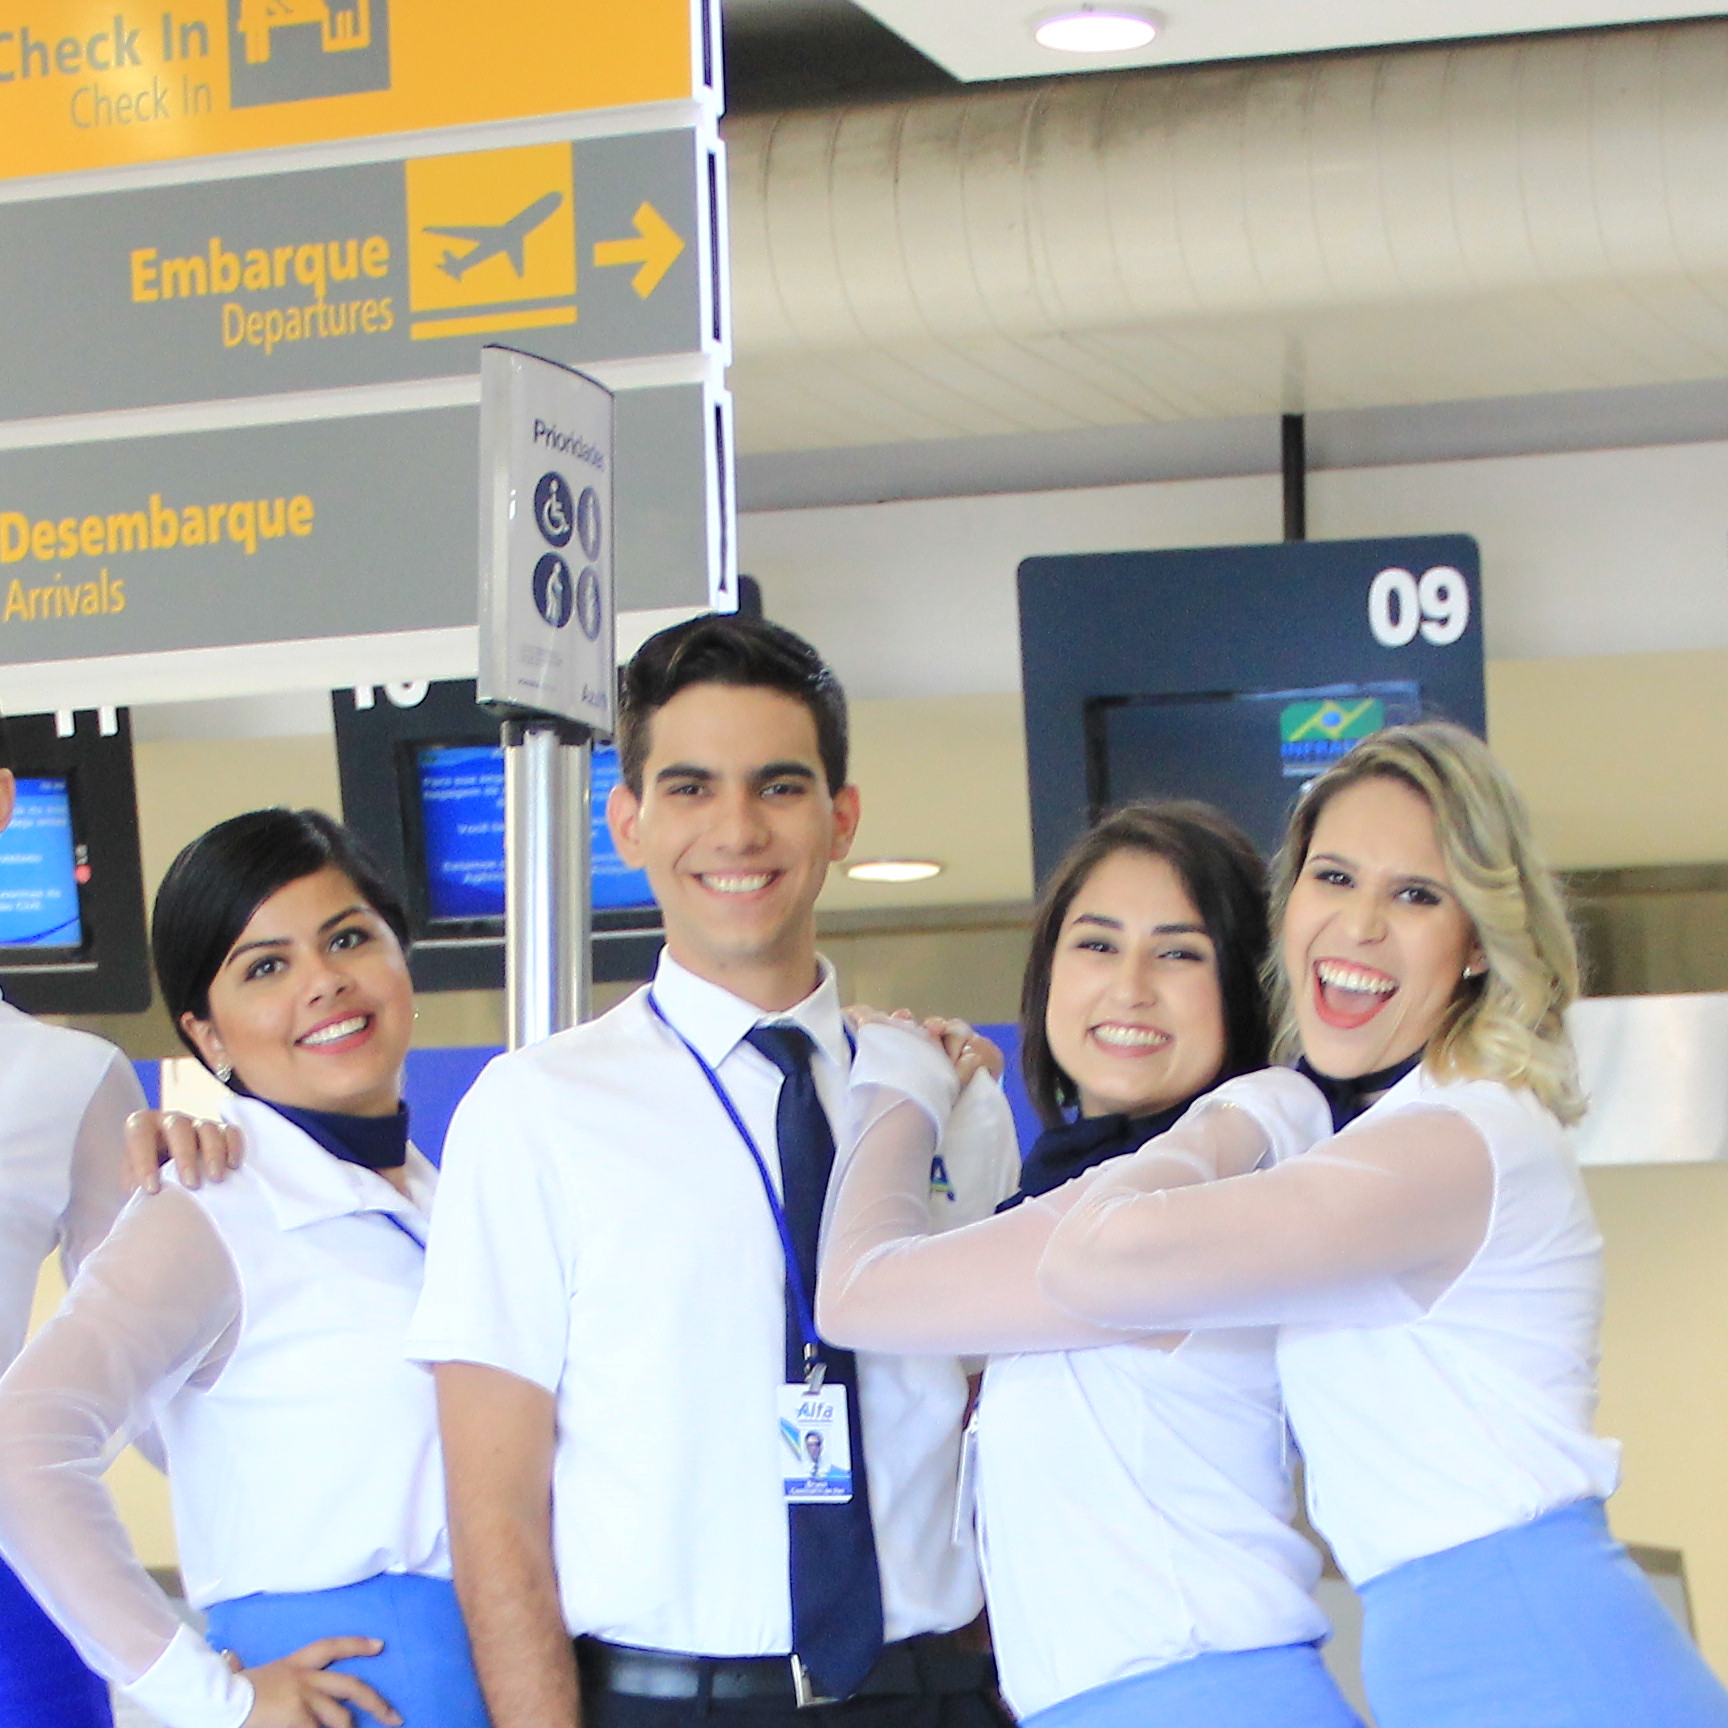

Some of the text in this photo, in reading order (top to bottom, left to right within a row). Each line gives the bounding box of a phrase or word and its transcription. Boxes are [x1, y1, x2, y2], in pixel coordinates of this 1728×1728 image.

[162, 12, 210, 62] In
[70, 75, 213, 130] Check In
[129, 234, 392, 302] Embarque
[222, 297, 395, 355] Departures
[2, 568, 127, 622] Arrivals
[1368, 565, 1471, 648] 09
[796, 1401, 834, 1419] Alfa
